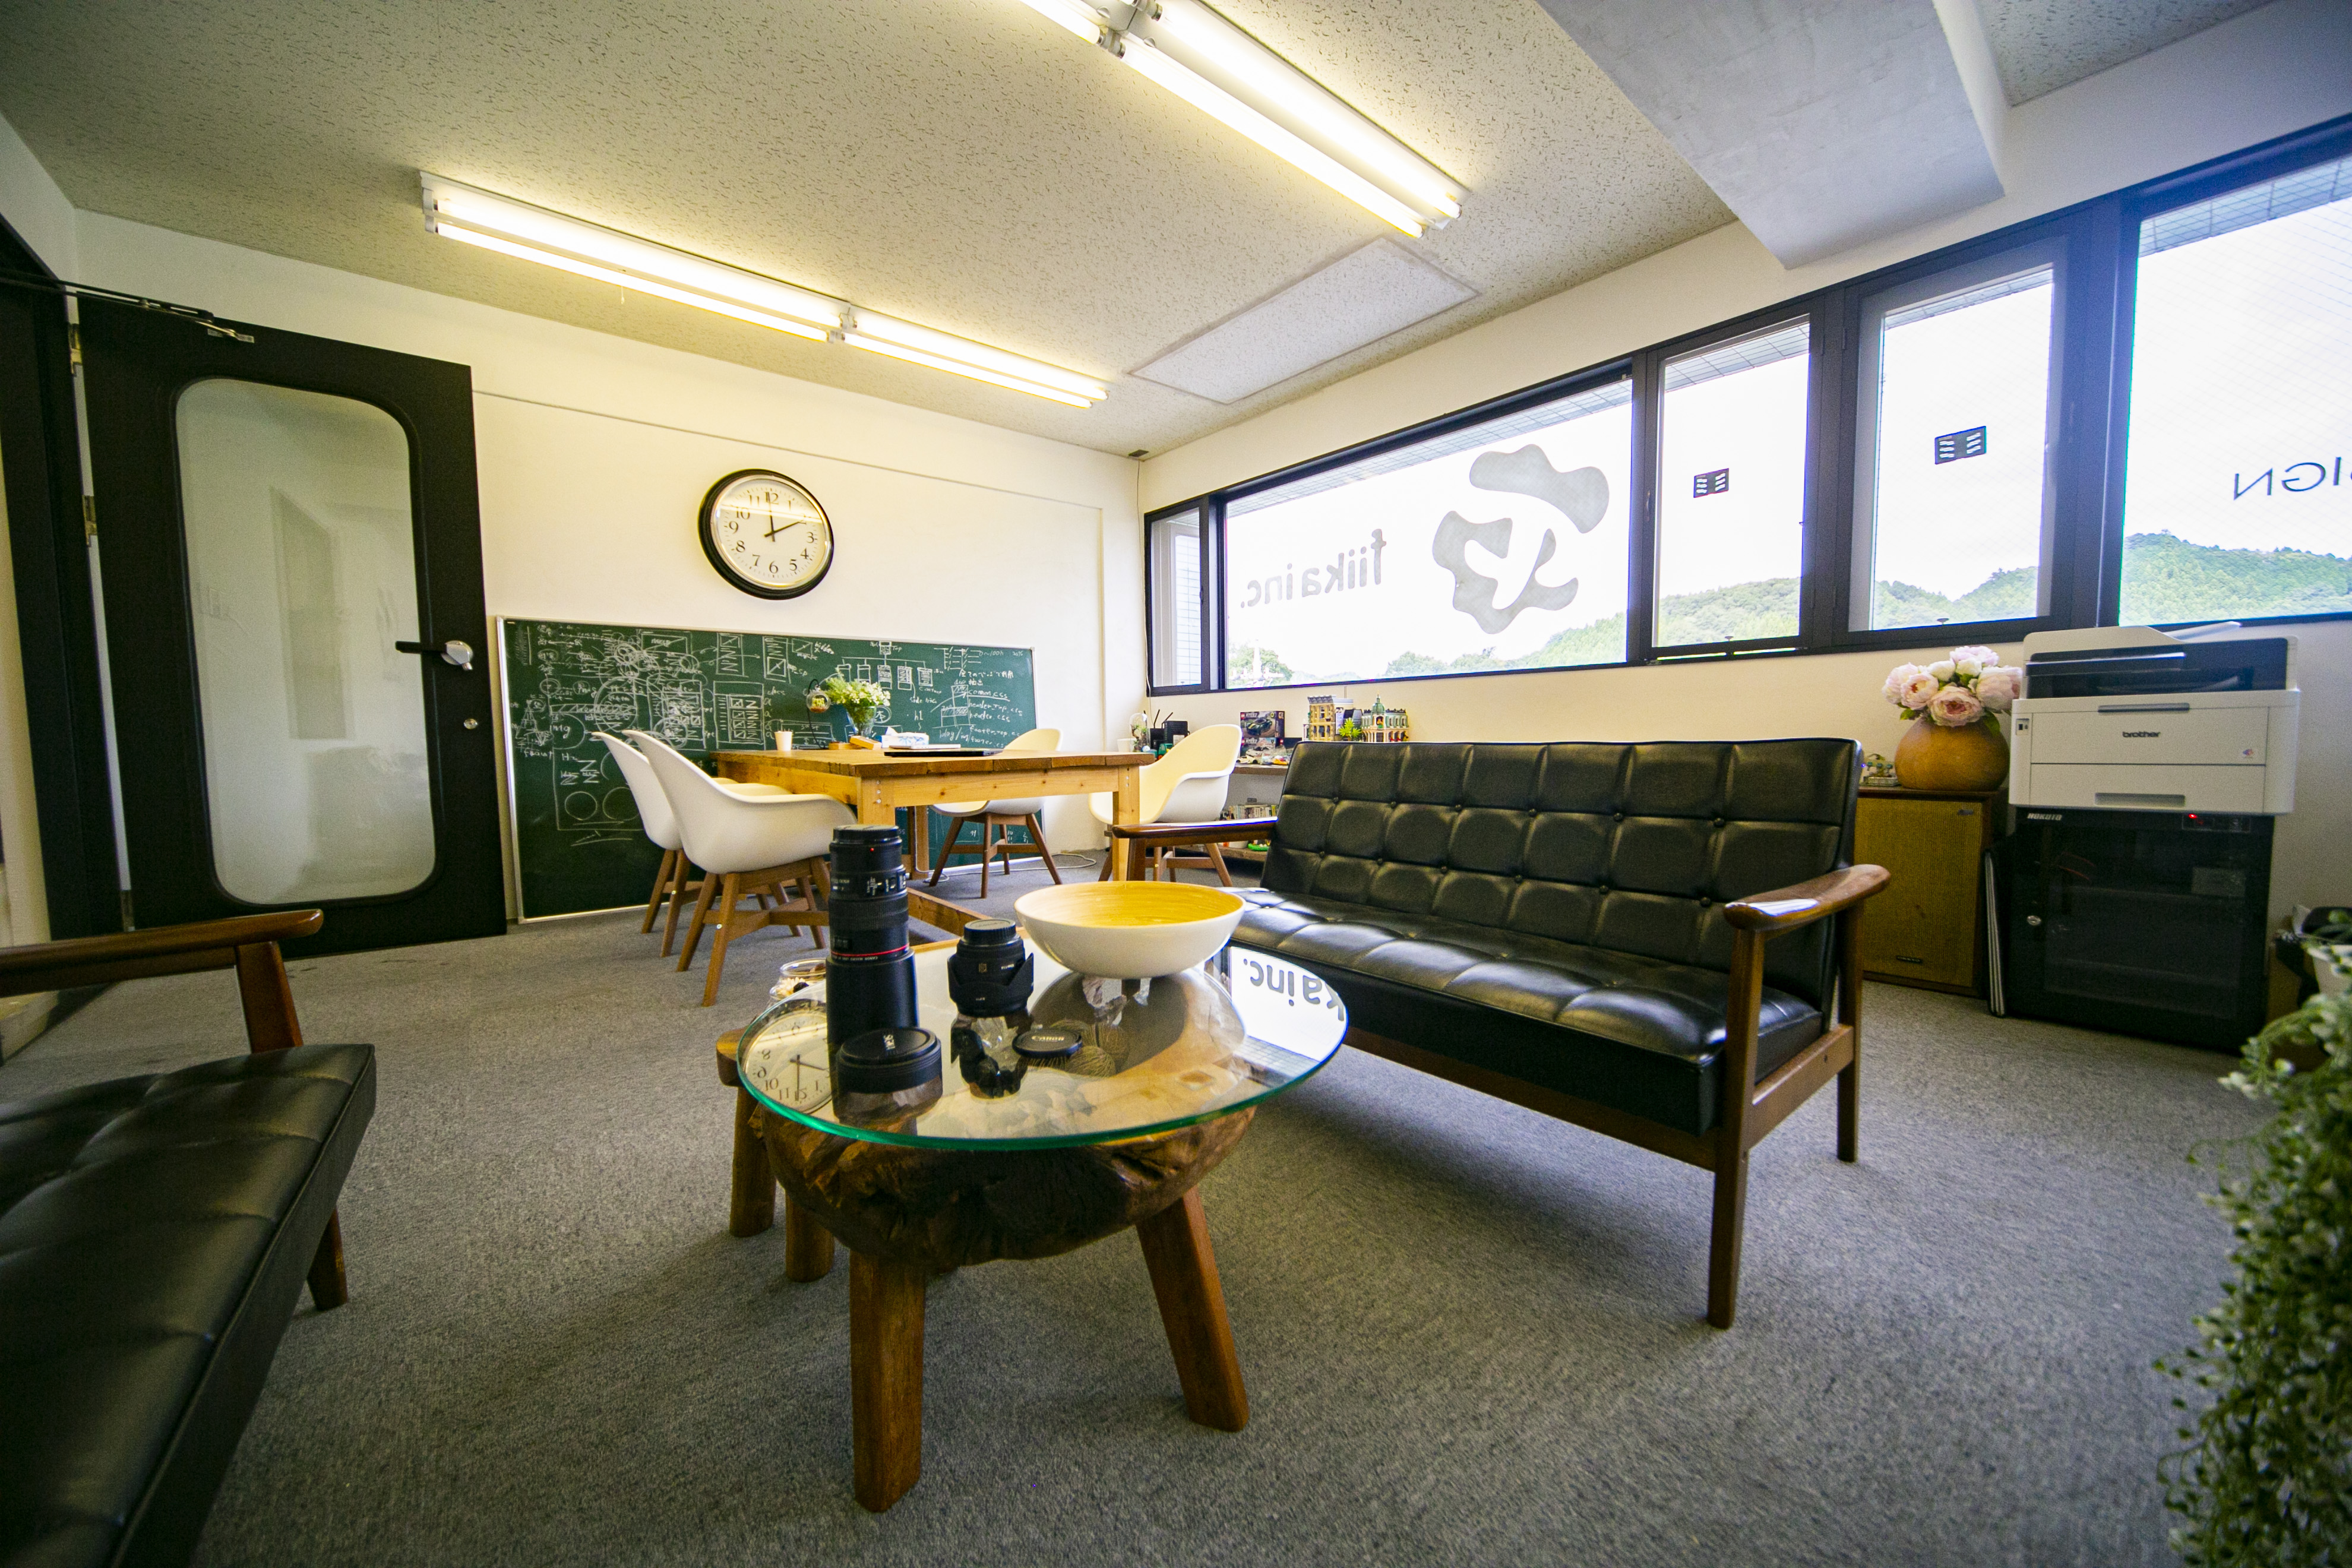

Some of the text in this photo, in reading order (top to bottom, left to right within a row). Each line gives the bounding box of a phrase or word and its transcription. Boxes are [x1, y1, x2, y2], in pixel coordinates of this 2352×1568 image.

[749, 495, 760, 507] 11
[765, 492, 779, 504] 12
[736, 507, 750, 520] 10
[729, 521, 739, 534] 9
[806, 532, 814, 543] 3
[735, 540, 745, 552] 8
[800, 548, 809, 559] 4
[752, 554, 760, 566] 7
[789, 559, 798, 571] 5
[769, 561, 778, 574] 6
